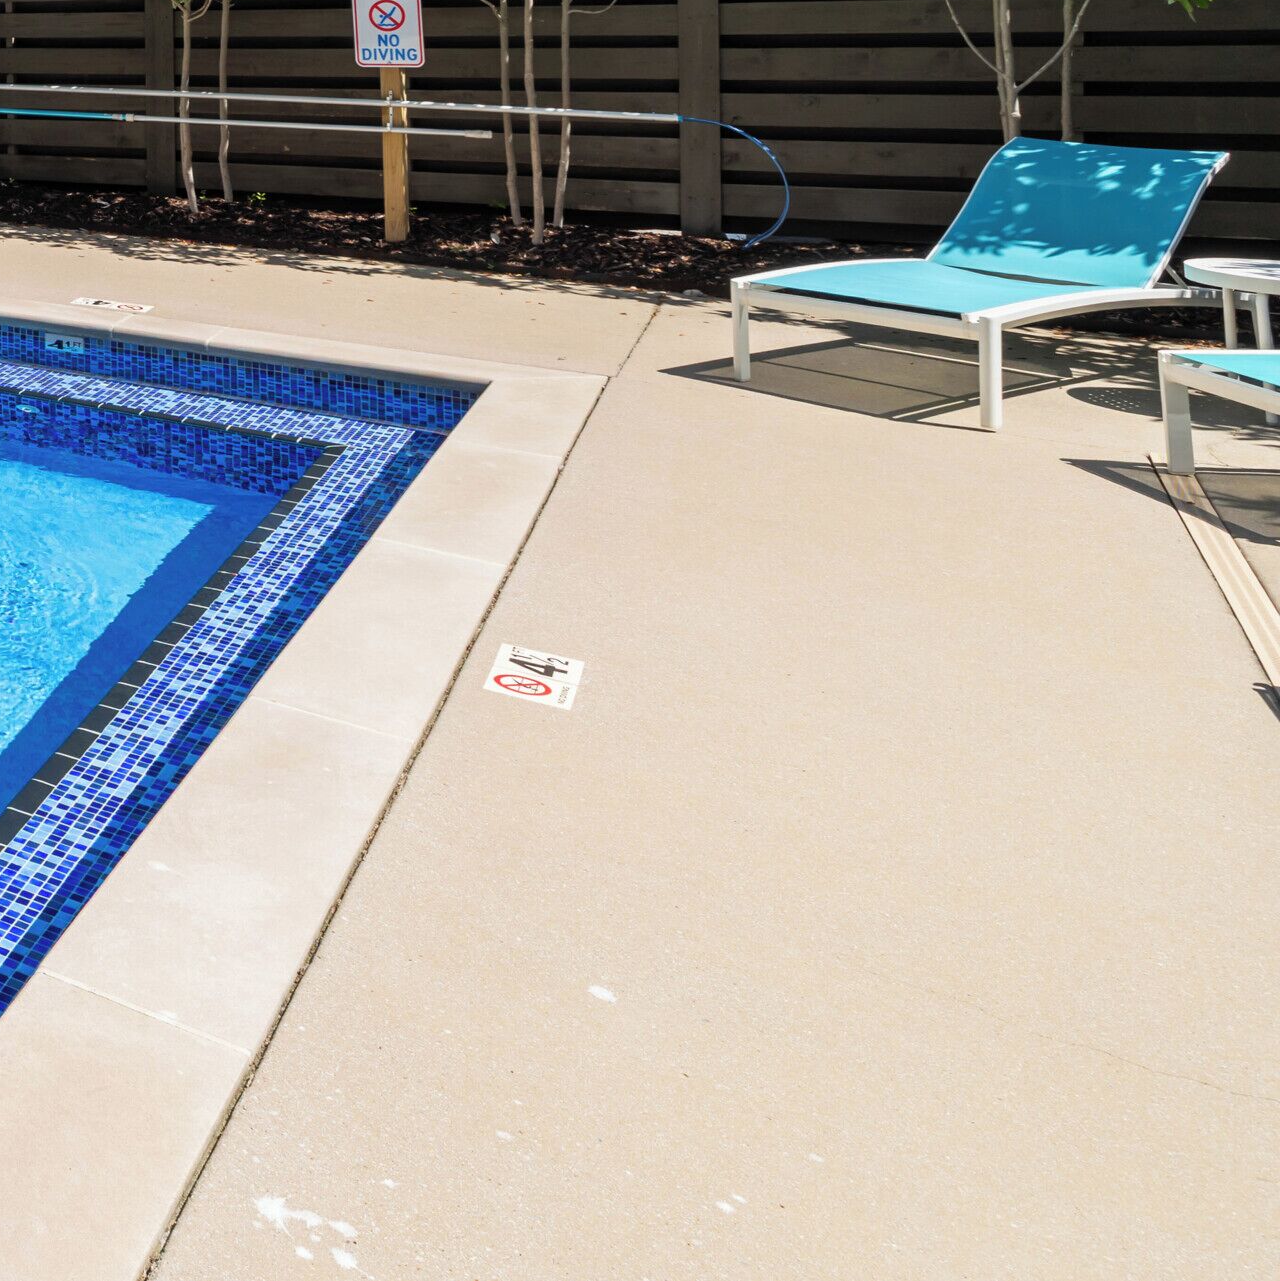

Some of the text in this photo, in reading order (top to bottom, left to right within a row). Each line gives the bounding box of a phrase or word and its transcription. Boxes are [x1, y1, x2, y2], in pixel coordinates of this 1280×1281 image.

[377, 34, 399, 47] NO
[362, 48, 417, 61] DIVING
[508, 657, 569, 678] 4
